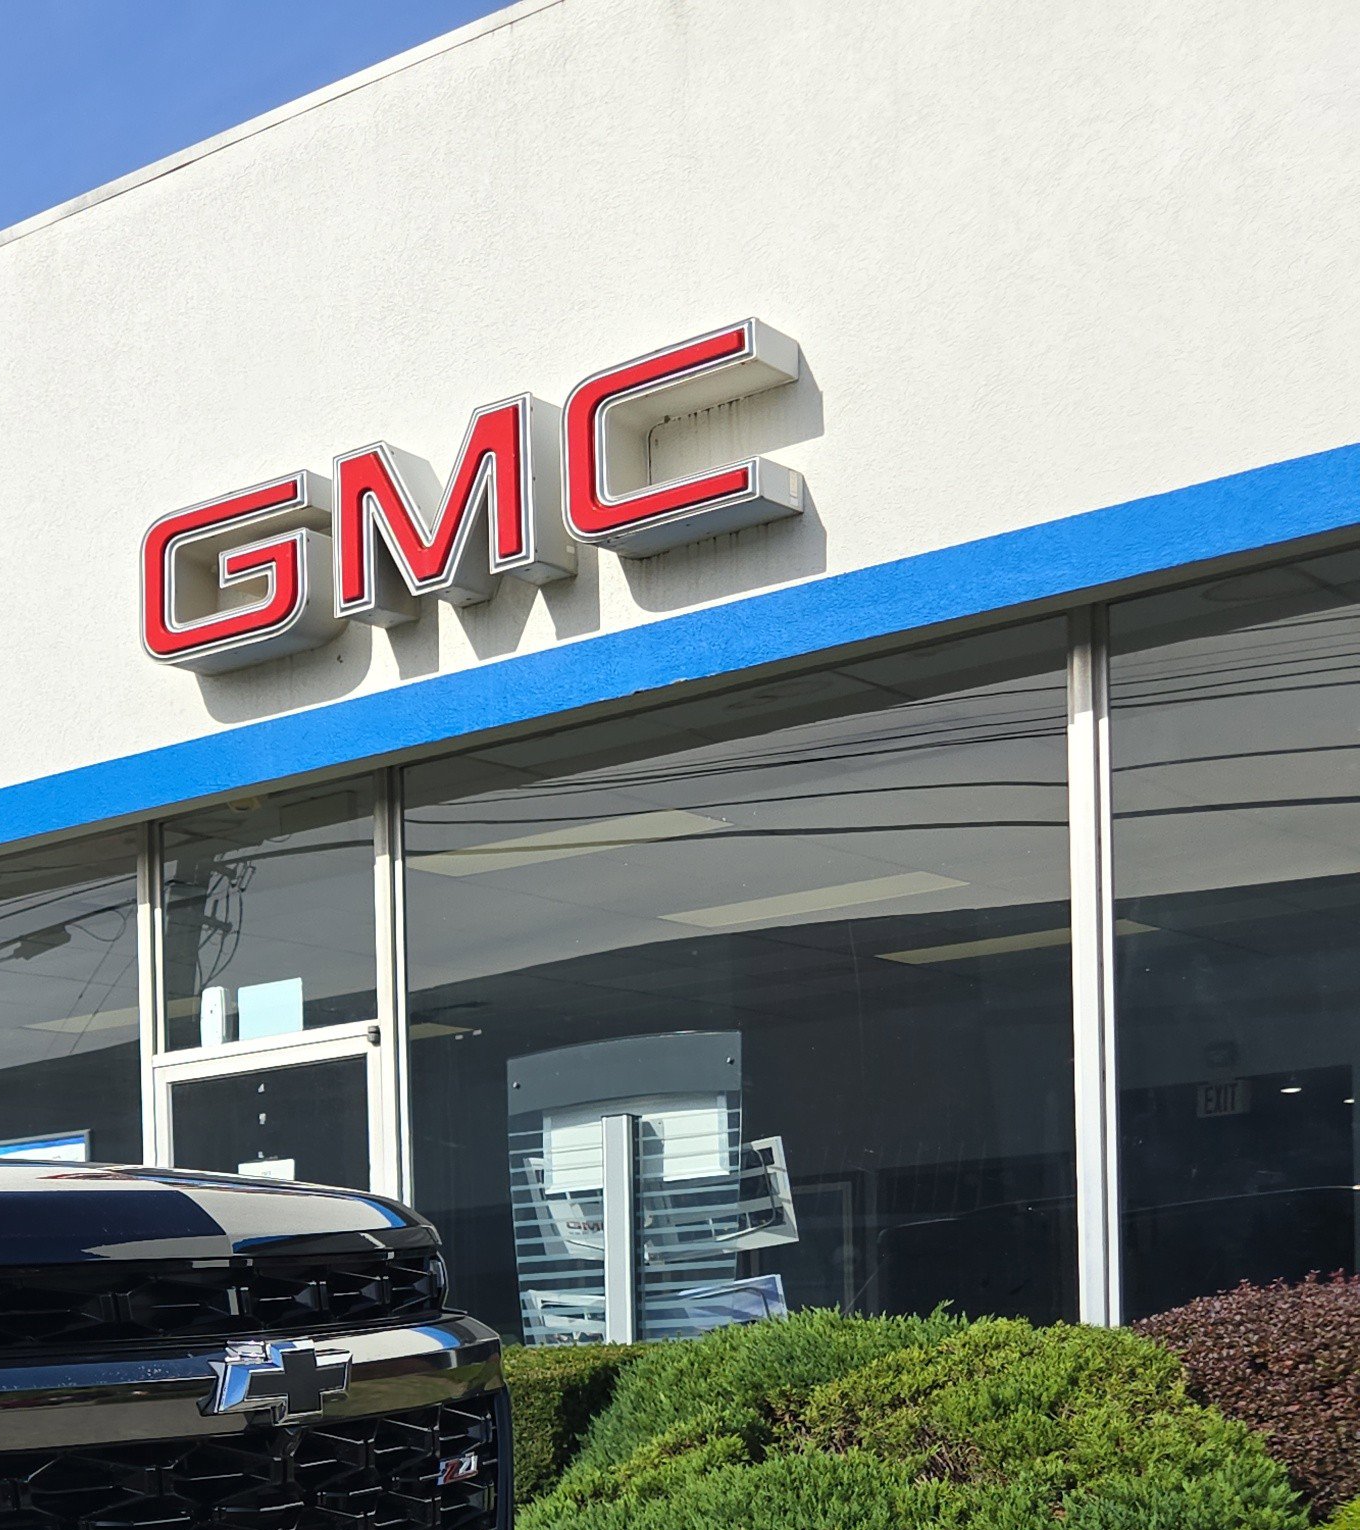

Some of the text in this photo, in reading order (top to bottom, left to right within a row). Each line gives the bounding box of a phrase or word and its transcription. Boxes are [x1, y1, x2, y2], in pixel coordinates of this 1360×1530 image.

[140, 316, 804, 674] GMC
[1204, 1083, 1238, 1115] EXIT
[566, 1221, 603, 1231] GM
[438, 1451, 478, 1486] Z71
